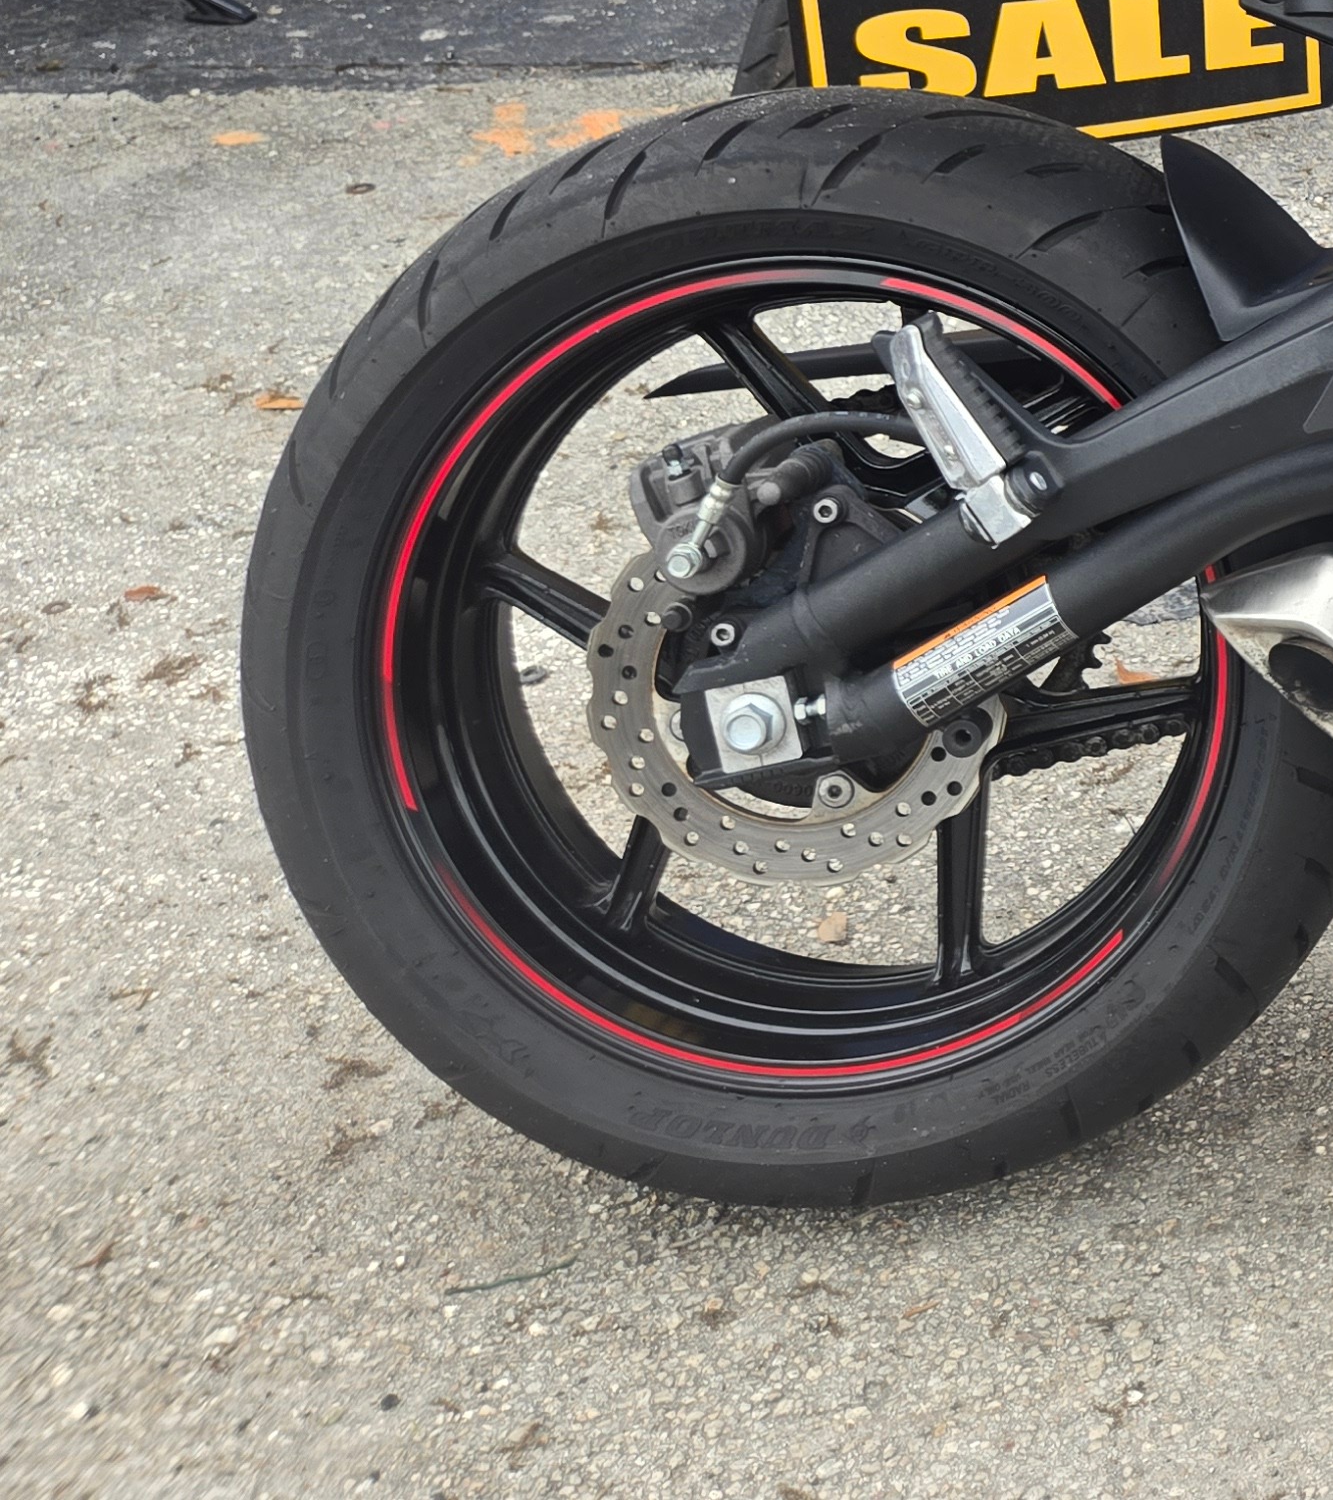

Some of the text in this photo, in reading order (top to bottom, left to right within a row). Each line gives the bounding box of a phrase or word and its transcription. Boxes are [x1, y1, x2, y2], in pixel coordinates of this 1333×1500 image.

[955, 653, 974, 670] AND
[975, 638, 998, 658] LOAD
[999, 626, 1022, 644] DATA
[628, 1103, 836, 1153] DUNLOP
